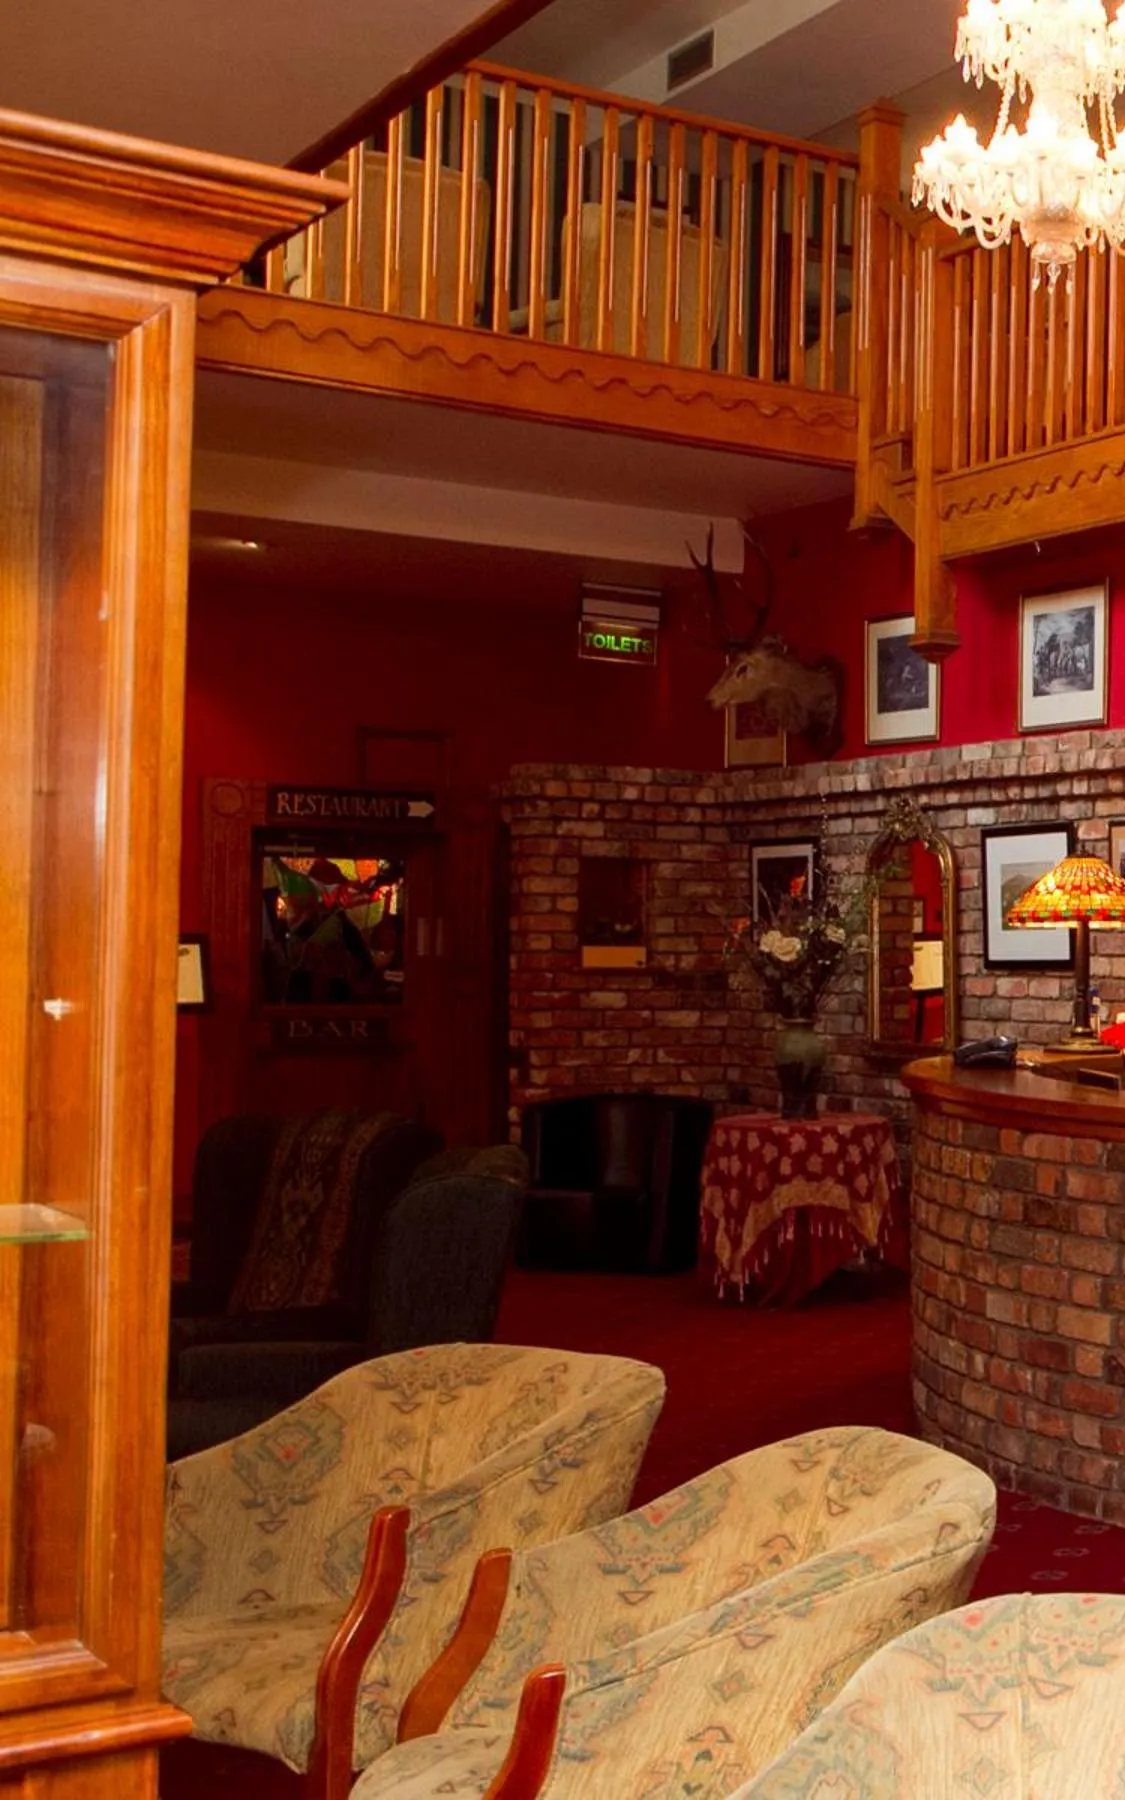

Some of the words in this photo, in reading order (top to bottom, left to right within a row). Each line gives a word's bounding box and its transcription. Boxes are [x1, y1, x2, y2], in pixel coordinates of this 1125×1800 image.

[583, 632, 653, 653] TOILETS
[276, 791, 401, 819] RESTAURANT
[287, 1019, 369, 1038] BAR
